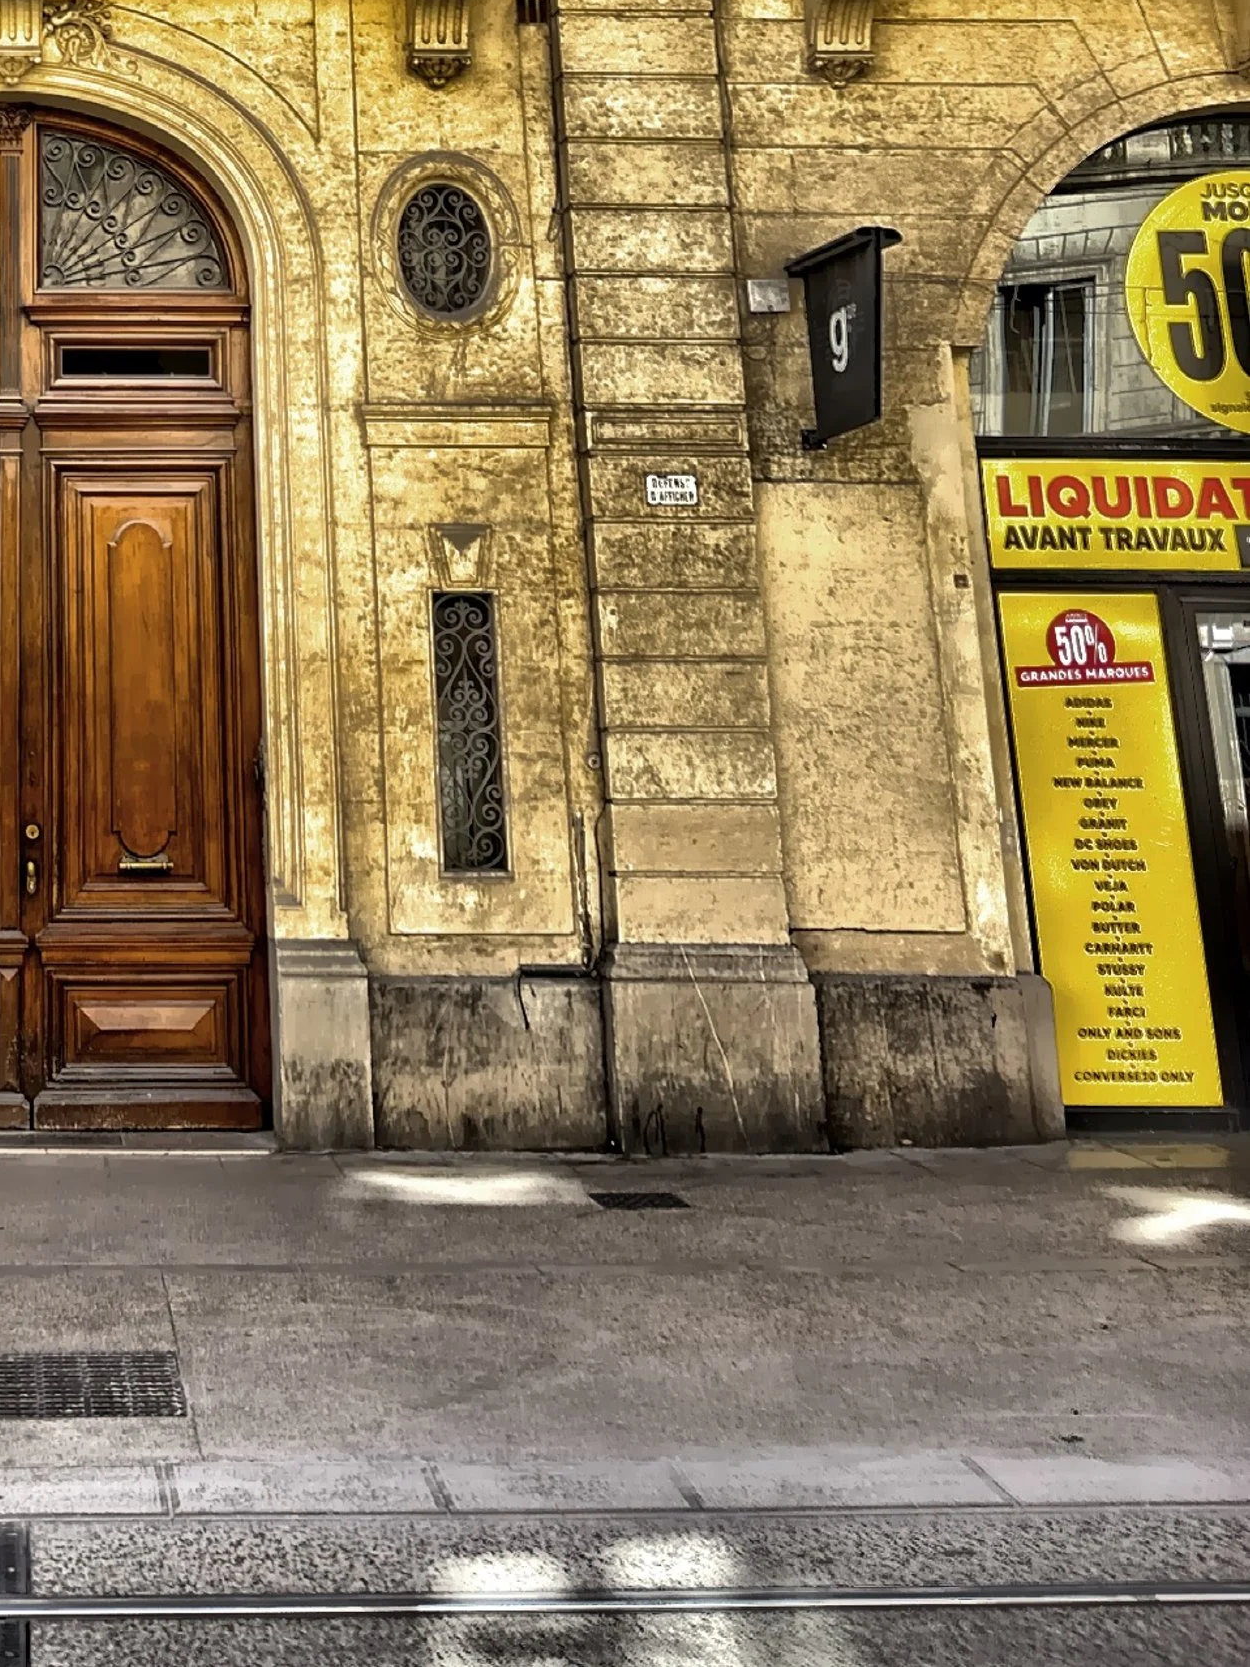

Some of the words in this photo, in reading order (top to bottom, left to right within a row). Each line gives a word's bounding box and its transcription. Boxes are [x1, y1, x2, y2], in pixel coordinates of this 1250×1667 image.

[1003, 524, 1092, 551] AVANT
[1099, 525, 1228, 552] TRAVAUX
[1054, 624, 1108, 666] 50%
[1020, 668, 1082, 682] GRANDES
[1085, 666, 1149, 680] MARQUES
[1064, 697, 1113, 709] ADIDAS
[1075, 717, 1106, 728] NIKE
[1075, 757, 1116, 769] PUMA
[1052, 777, 1083, 788] NEW
[1084, 777, 1144, 789] BALANCE
[1083, 797, 1118, 810] OBEY
[1074, 838, 1094, 850] DC
[1095, 838, 1138, 850] SHOES
[1070, 859, 1100, 871] VON
[1101, 859, 1147, 871] DUTCH
[1093, 880, 1129, 892] VEJA
[1091, 901, 1136, 913] POLAR
[1091, 922, 1141, 934] BUTTER
[1083, 942, 1153, 955] CARHARTT
[1096, 963, 1146, 976] STUSSY
[1107, 1006, 1146, 1018] FARCI
[1077, 1028, 1111, 1039] ONLY
[1114, 1028, 1143, 1040] AND
[1145, 1028, 1182, 1040] SONS
[1106, 1049, 1158, 1061] DICKIES
[1159, 1070, 1196, 1083] ONLY
